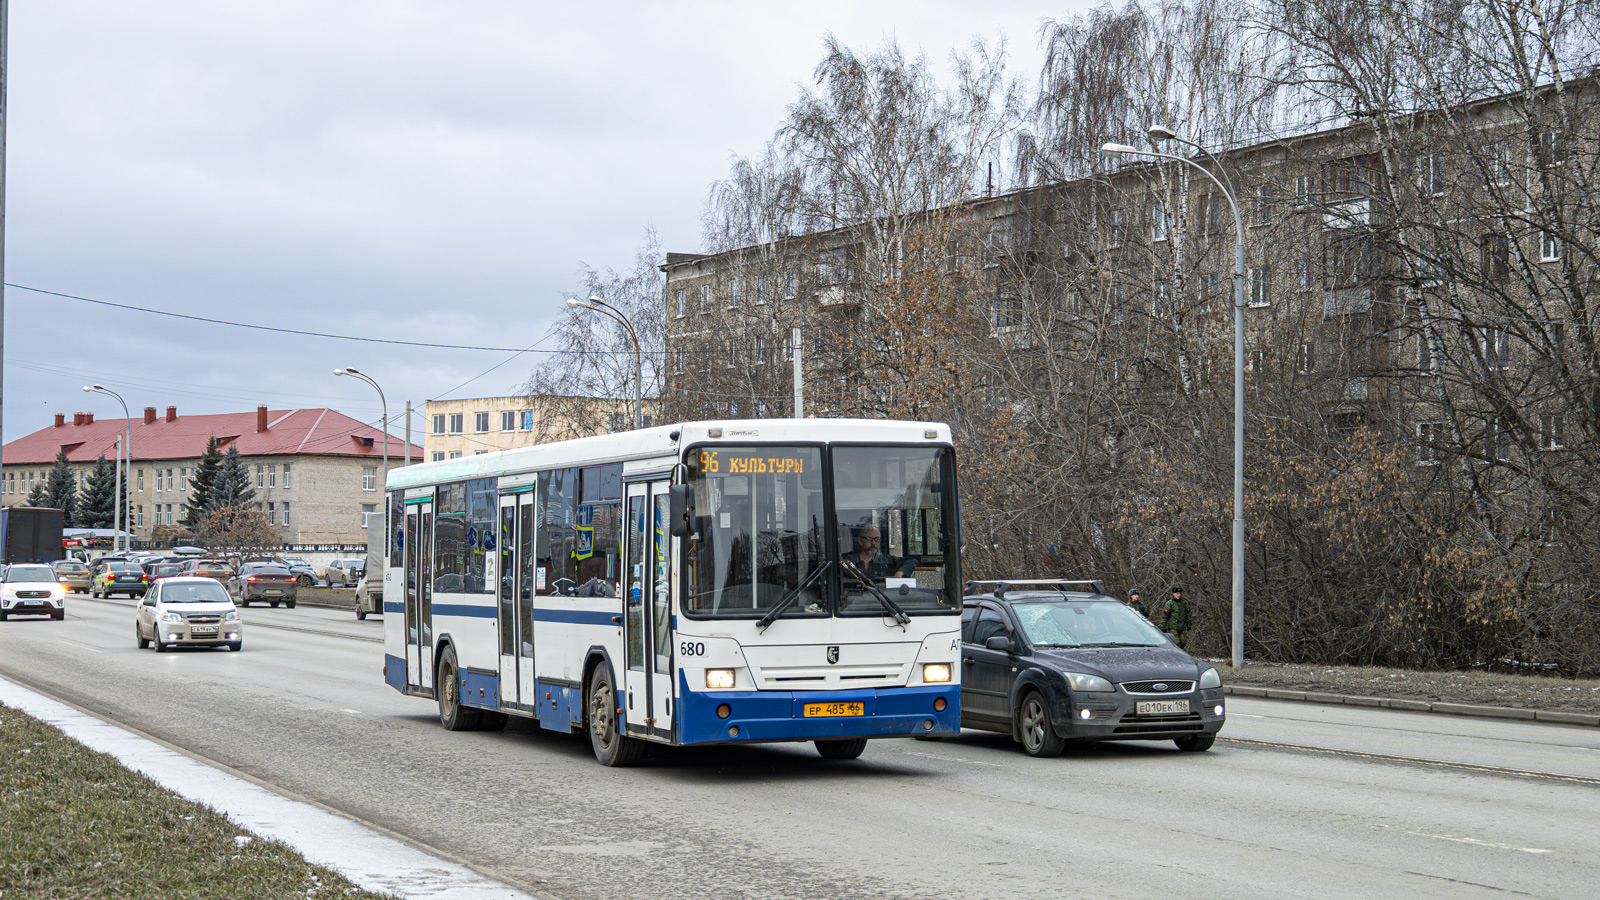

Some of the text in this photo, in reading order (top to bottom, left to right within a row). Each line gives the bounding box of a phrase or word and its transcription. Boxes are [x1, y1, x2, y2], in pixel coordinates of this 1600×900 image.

[700, 451, 804, 473] 96 КУЛЬТУРЫ
[680, 641, 705, 656] 680
[809, 706, 822, 716] ЕР
[826, 703, 845, 715] 485
[1139, 701, 1188, 713] Е010ЕК 196
